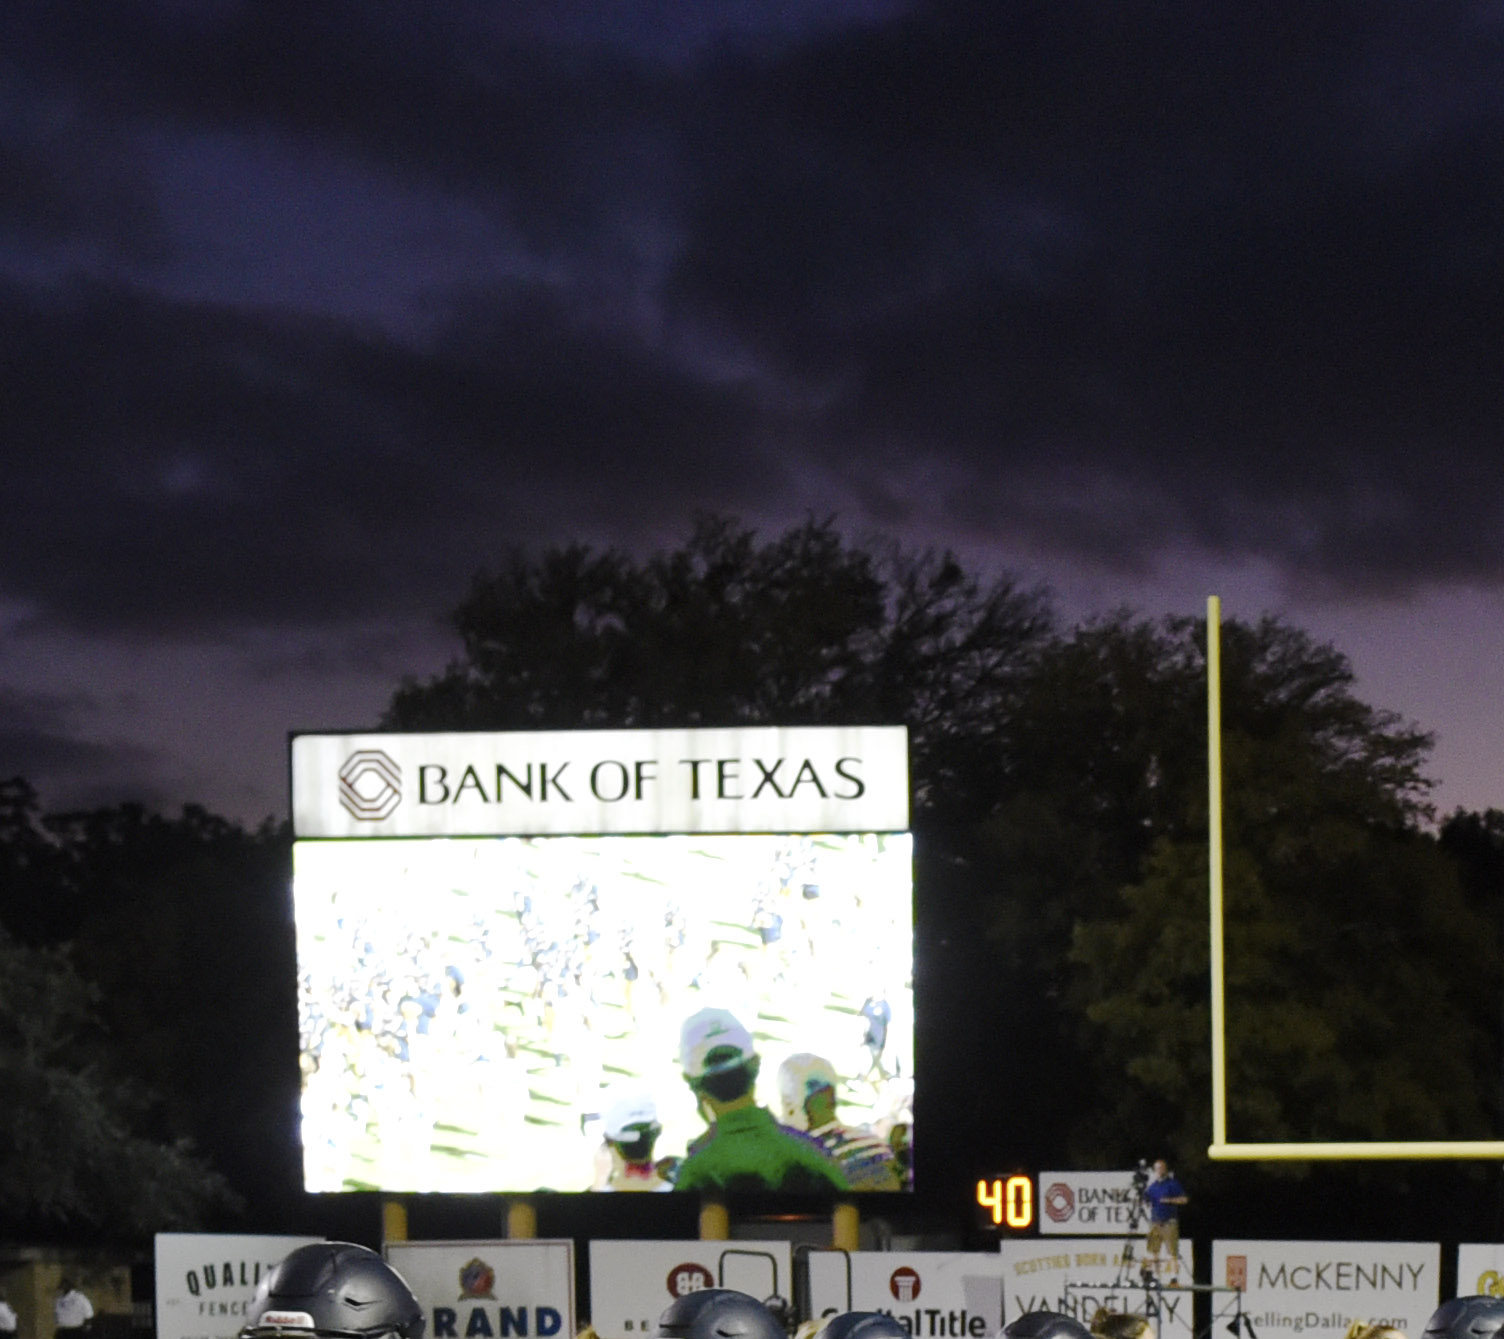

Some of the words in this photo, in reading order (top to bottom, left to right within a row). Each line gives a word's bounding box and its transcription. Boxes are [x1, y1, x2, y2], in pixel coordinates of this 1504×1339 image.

[417, 762, 575, 804] BANK
[589, 760, 657, 802] OF
[679, 756, 866, 801] TEXAS
[977, 1176, 1032, 1227] 40
[1078, 1206, 1102, 1223] OF
[1106, 1206, 1148, 1223] TEXA
[186, 1260, 274, 1297] QUALI
[432, 1305, 562, 1339] RAND
[1240, 1311, 1408, 1332] ellingDallacom
